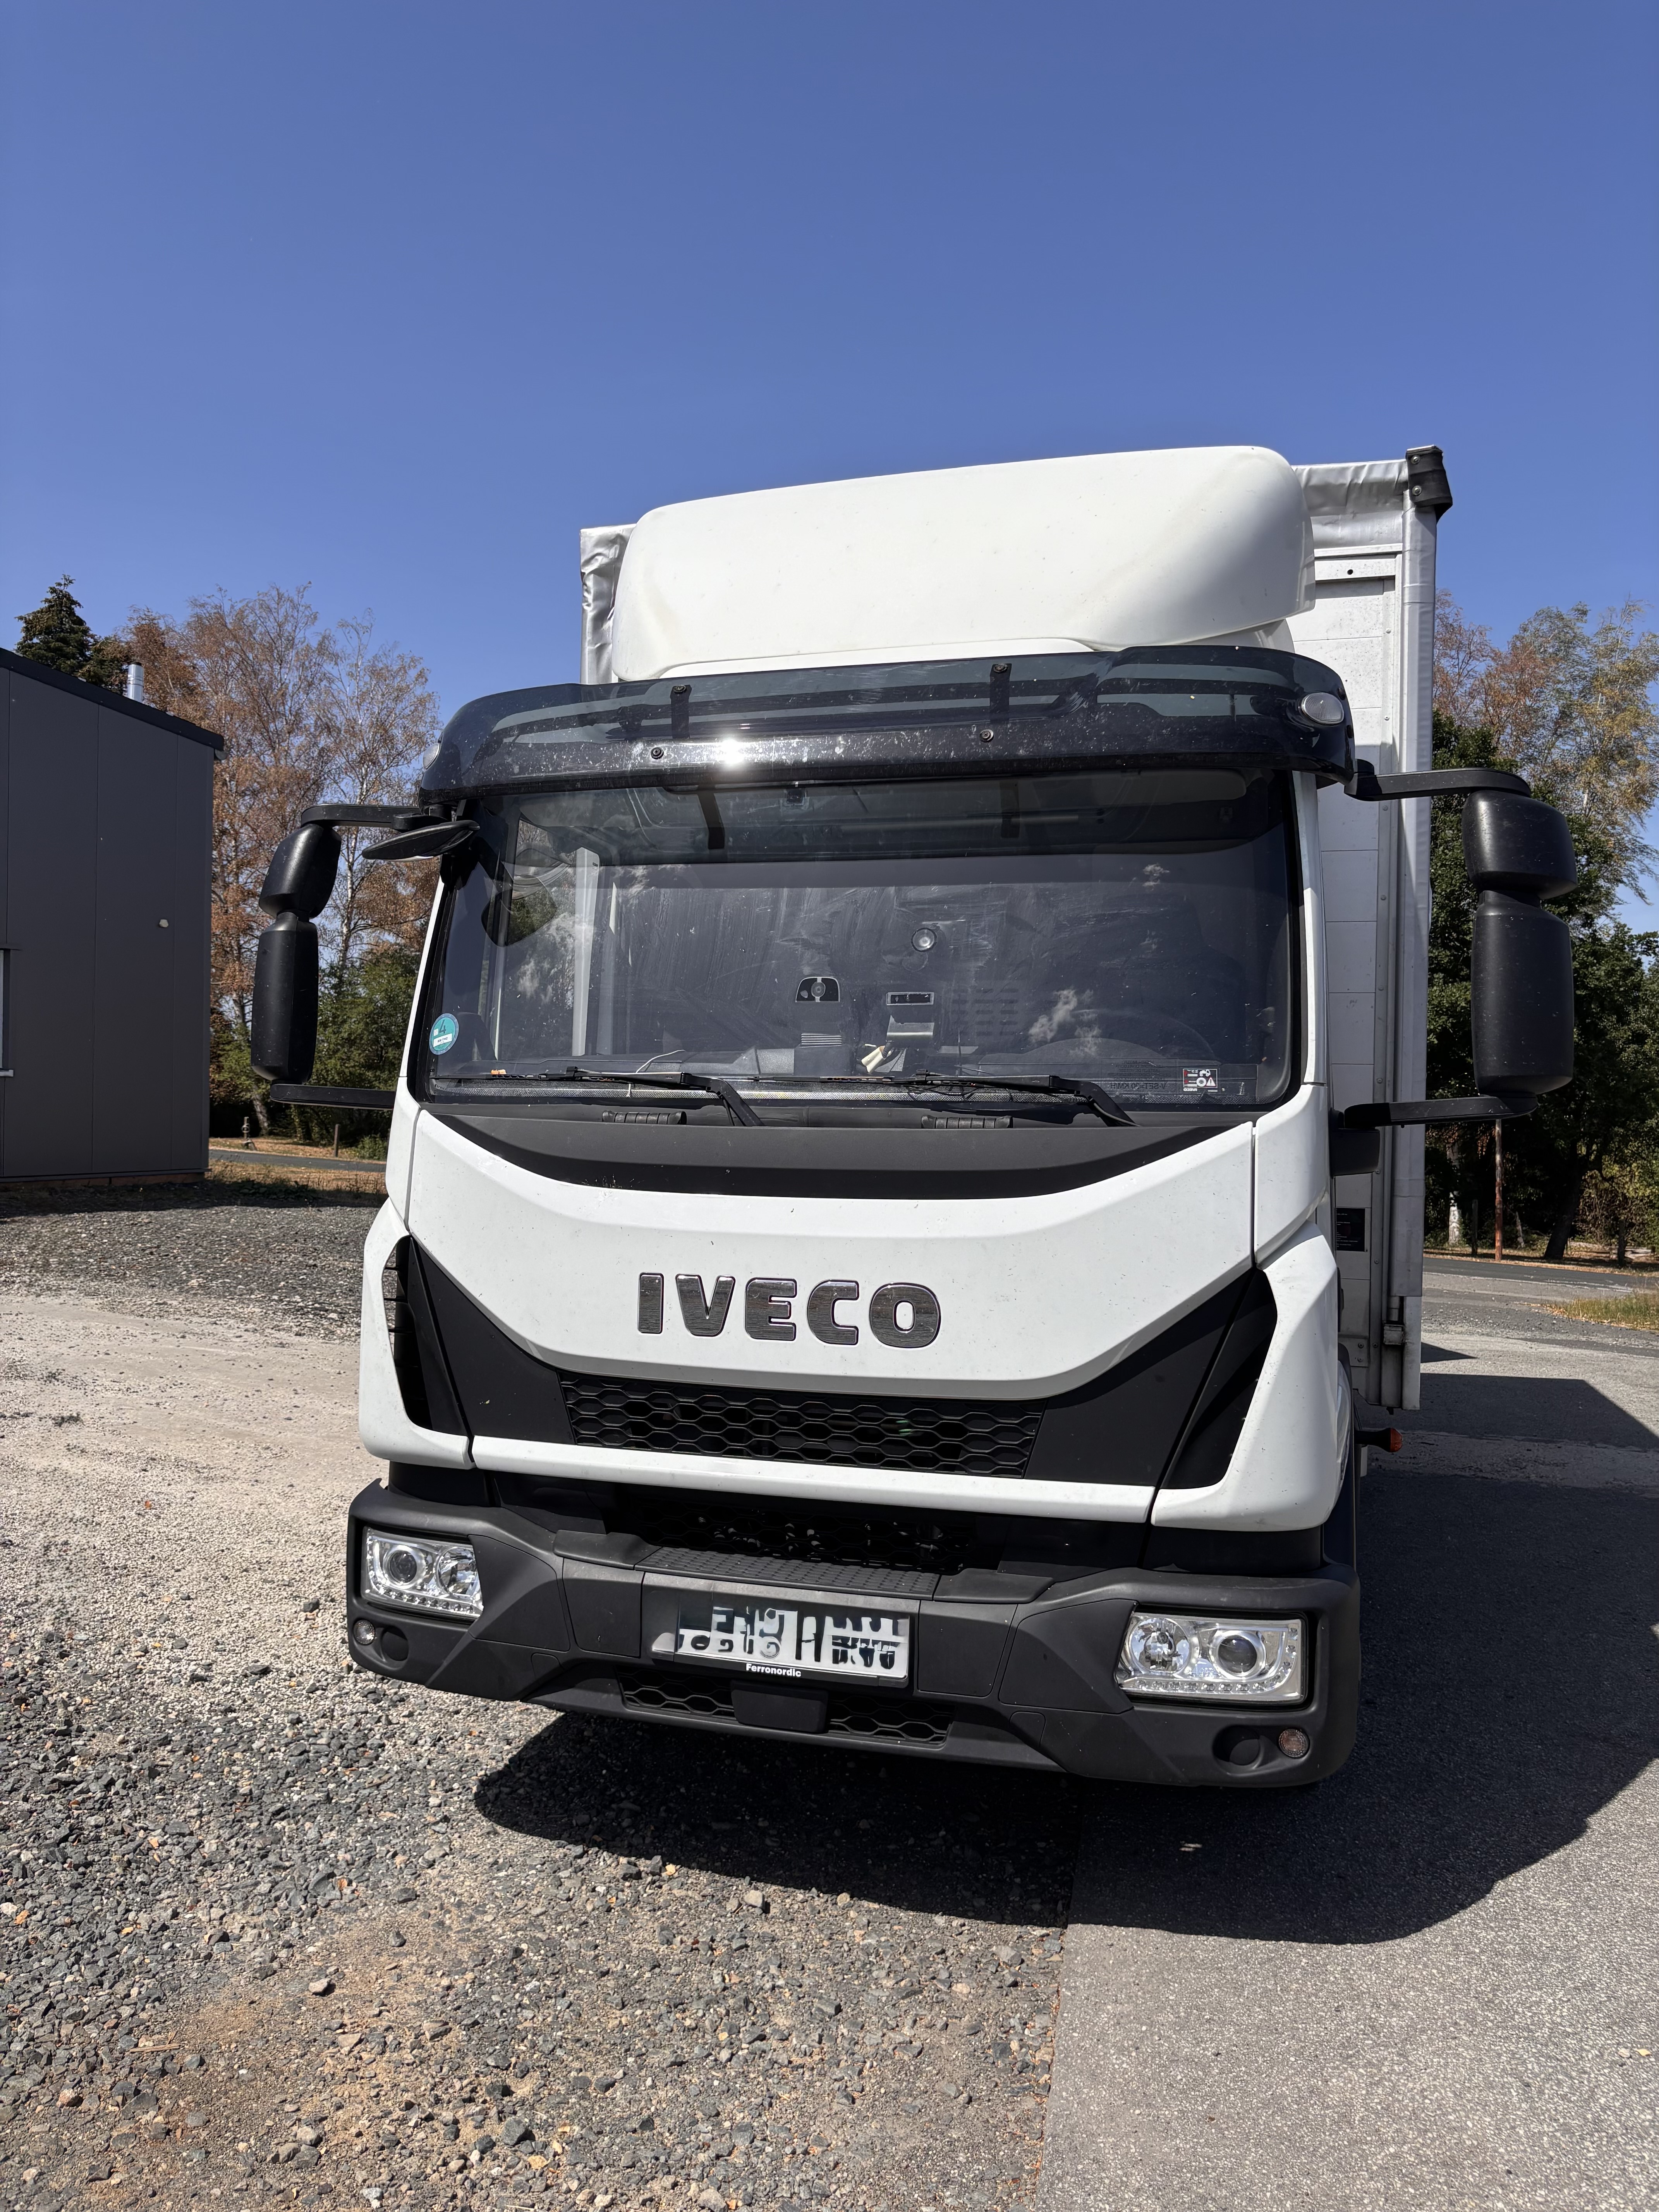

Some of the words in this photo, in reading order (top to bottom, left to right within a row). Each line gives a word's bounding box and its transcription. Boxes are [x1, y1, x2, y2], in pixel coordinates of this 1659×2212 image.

[439, 1019, 446, 1034] 4
[637, 1272, 941, 1348] IVECO
[746, 1663, 801, 1677] Ferronordic
